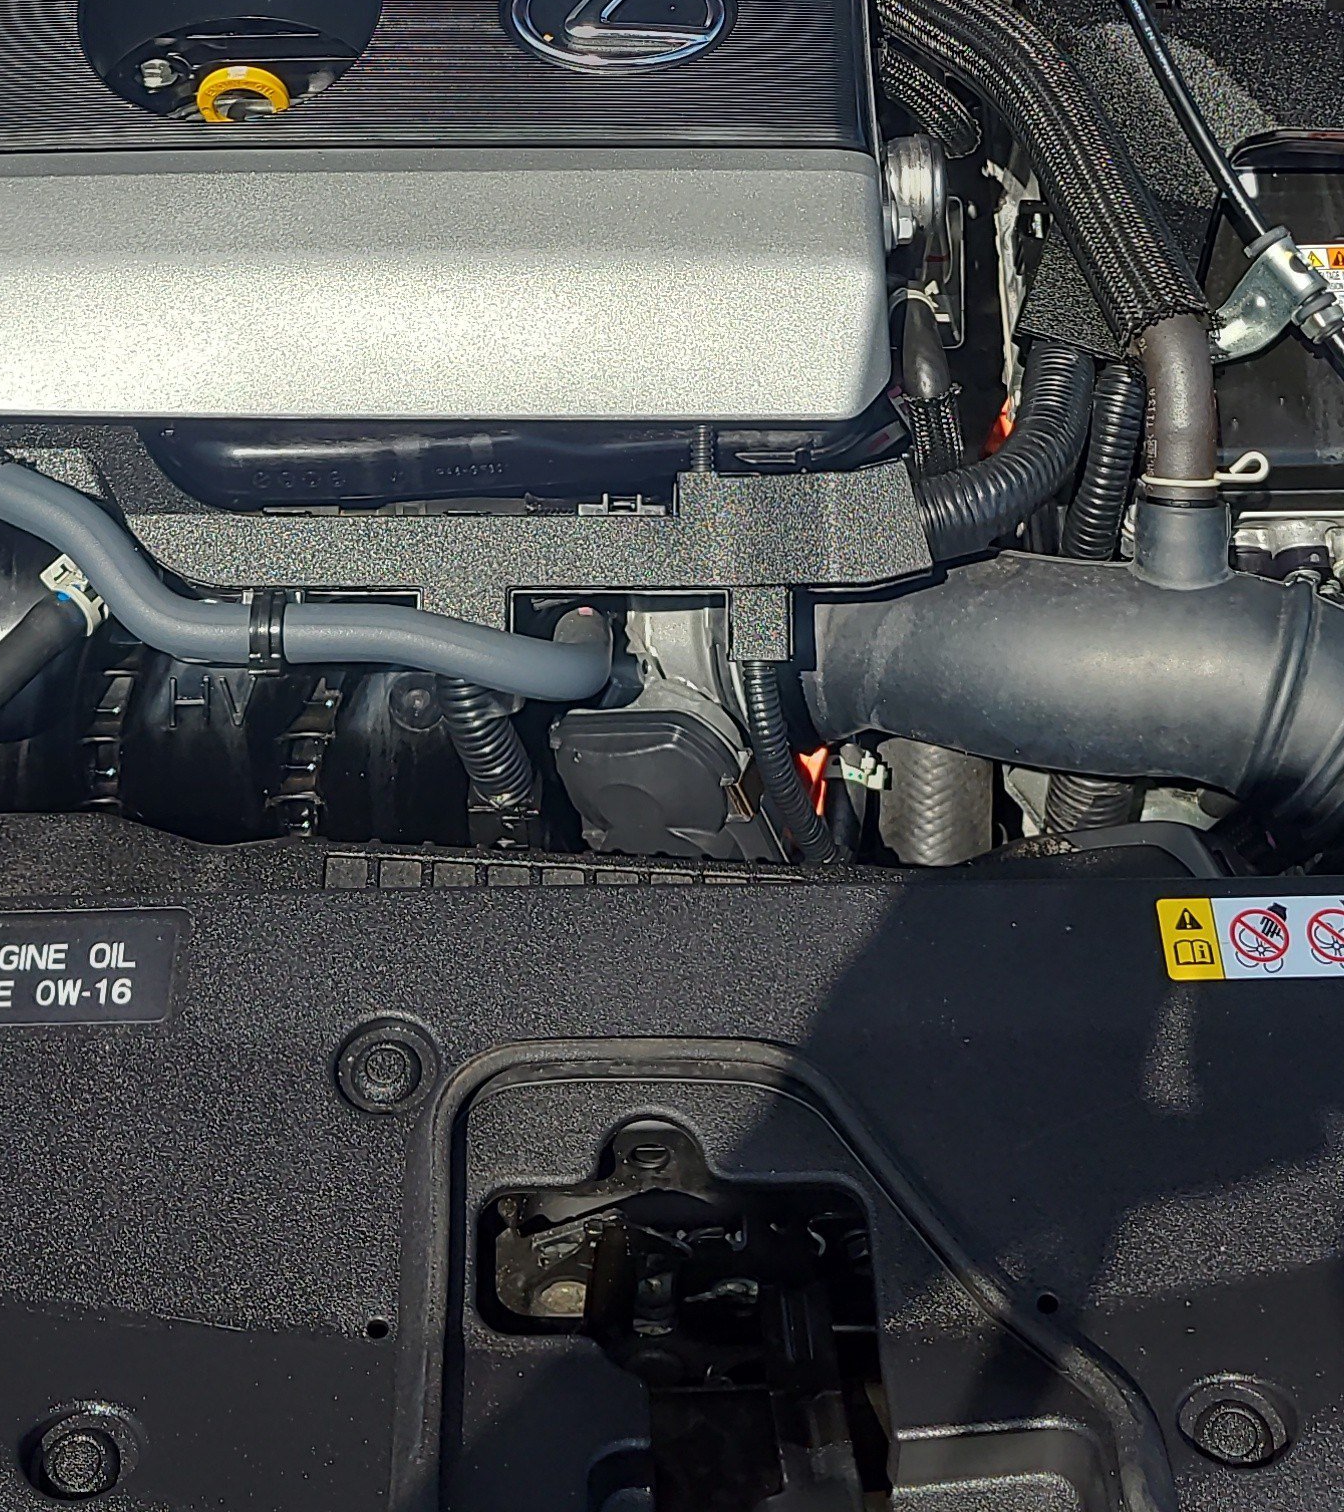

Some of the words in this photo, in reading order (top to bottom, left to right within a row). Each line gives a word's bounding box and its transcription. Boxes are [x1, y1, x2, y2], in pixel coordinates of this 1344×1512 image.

[1144, 26, 1156, 40] IN
[1154, 45, 1175, 80] JAPAN
[169, 674, 257, 728] HV
[88, 941, 137, 969] OIL
[35, 978, 133, 1007] 0W-16
